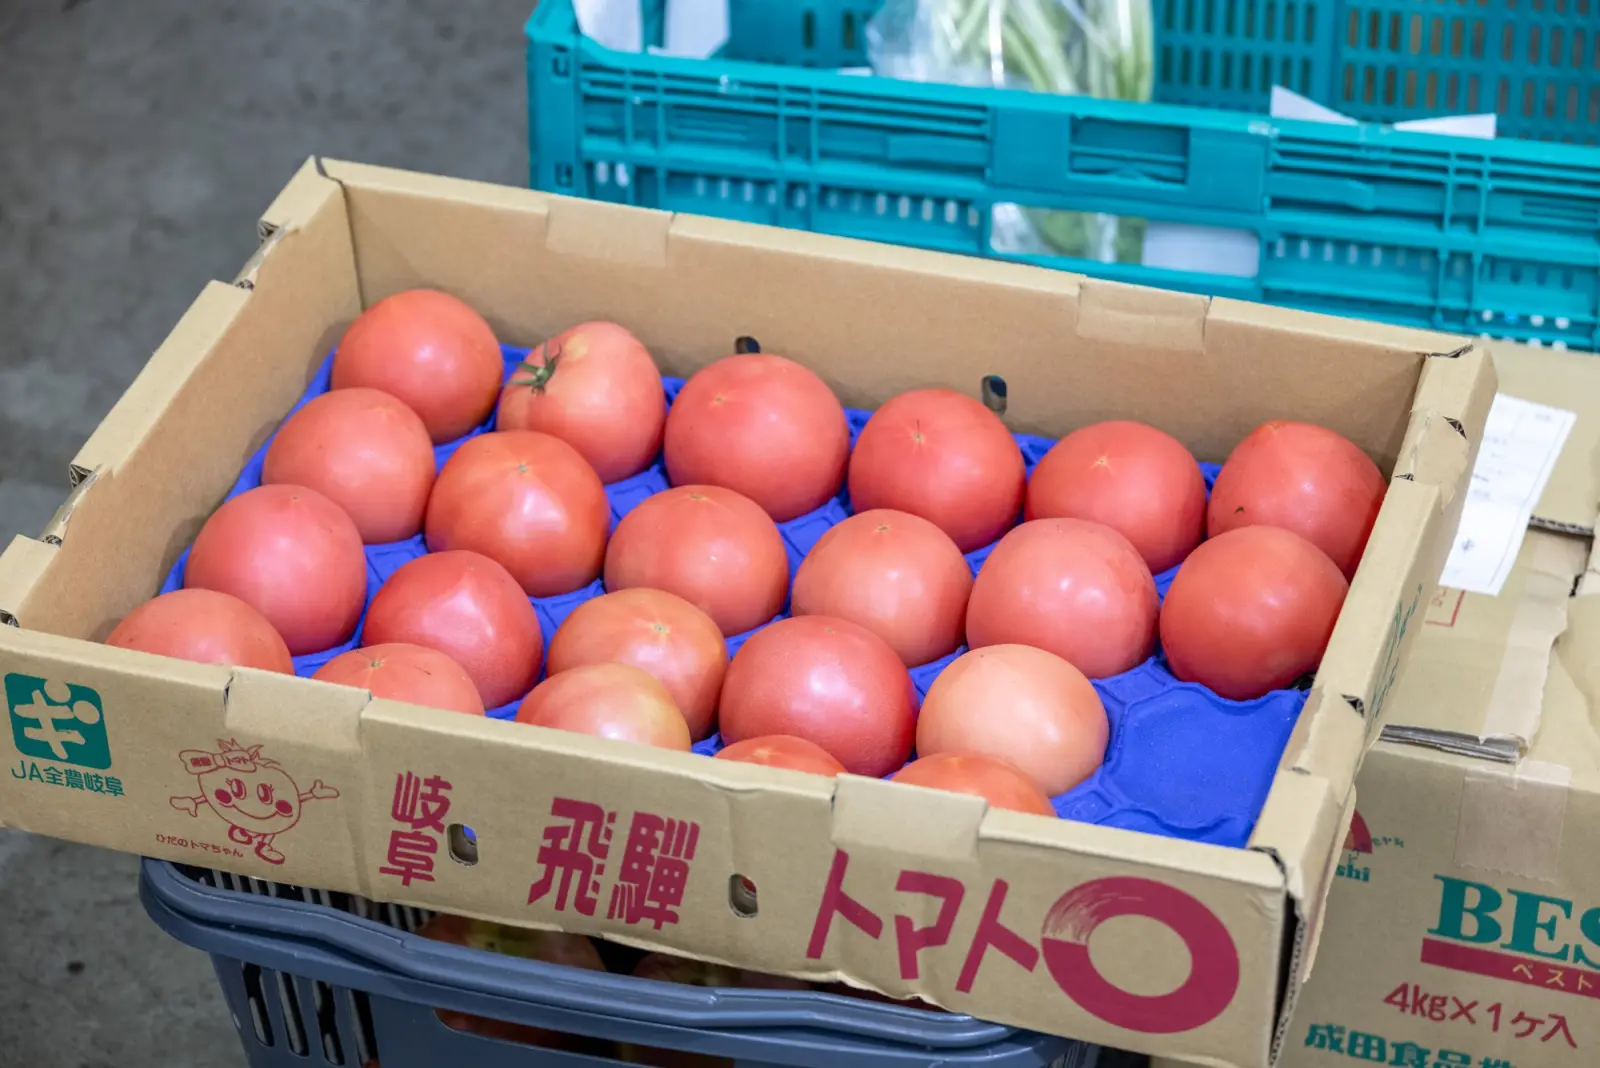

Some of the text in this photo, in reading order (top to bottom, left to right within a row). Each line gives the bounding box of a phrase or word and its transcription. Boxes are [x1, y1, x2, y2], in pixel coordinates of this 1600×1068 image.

[11, 760, 125, 796] JA全農岐阜
[156, 834, 243, 857] ひだのトマちゃん
[379, 771, 453, 887] 岐阜
[806, 848, 1040, 993] トマト
[1512, 963, 1593, 991] ベスト
